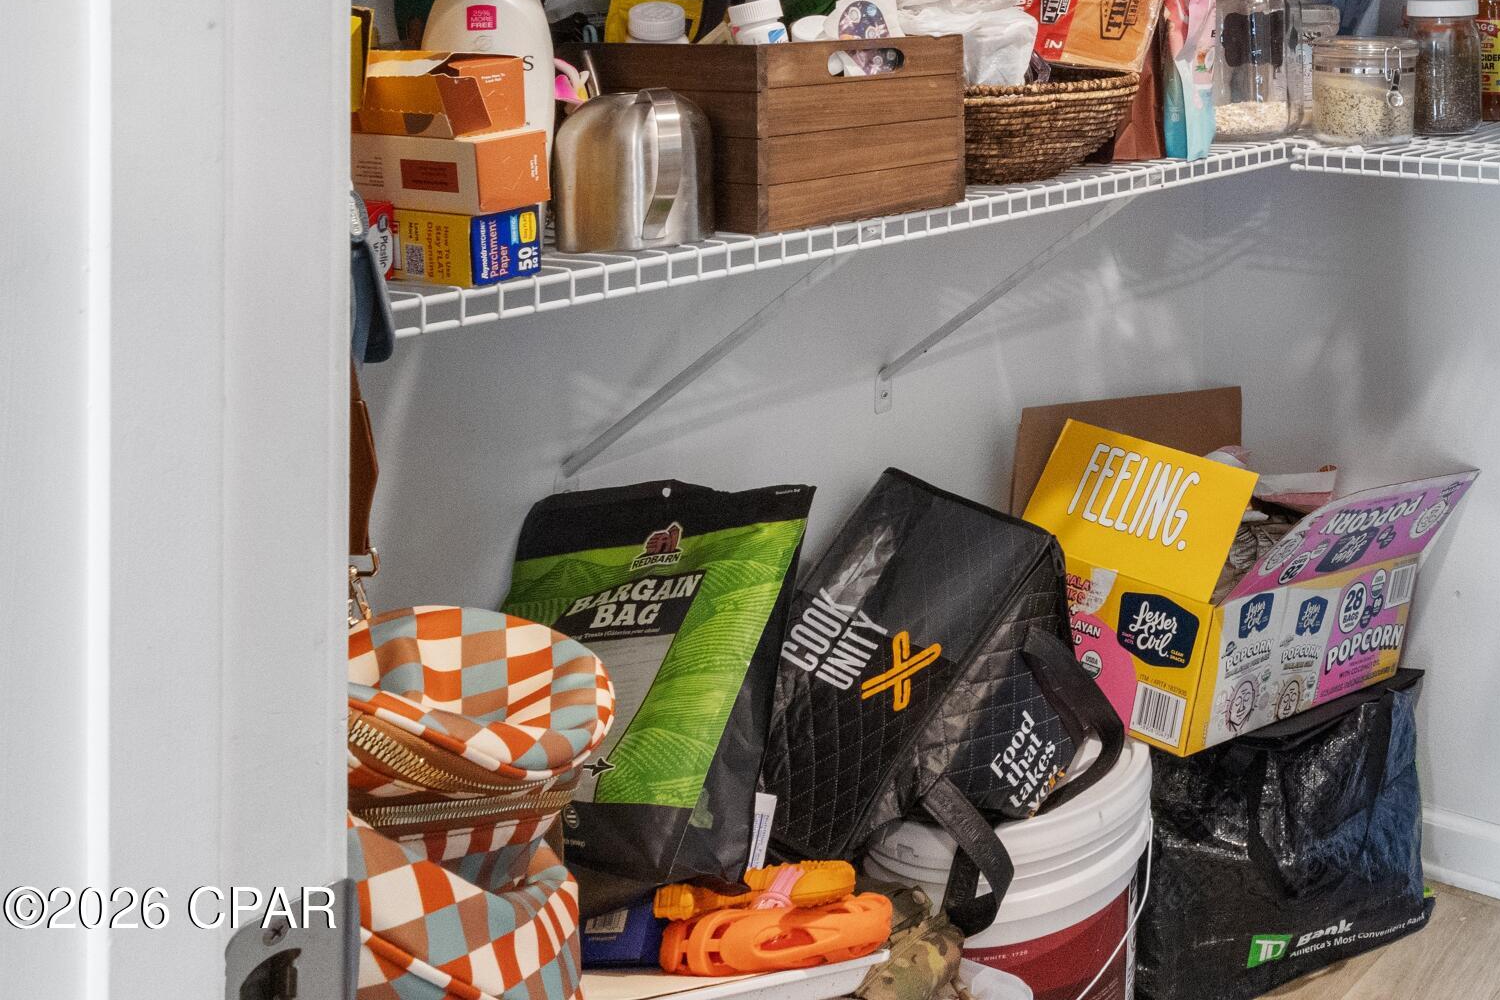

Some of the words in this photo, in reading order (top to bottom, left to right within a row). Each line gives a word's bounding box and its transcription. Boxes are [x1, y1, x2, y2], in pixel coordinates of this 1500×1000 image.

[380, 236, 388, 268] Plastic
[488, 219, 499, 278] Parchment
[499, 245, 511, 276] Paper
[518, 247, 533, 271] 50
[1067, 442, 1201, 551] FEELING.
[631, 552, 682, 569] REDBARN
[565, 573, 703, 617] BARGAIN
[1344, 587, 1365, 614] 28
[590, 602, 662, 629] BAG
[781, 587, 857, 672] COOK
[1129, 601, 1178, 634] Lesser
[815, 609, 889, 690] UNITY
[1226, 640, 1273, 672] POPCORN
[1325, 624, 1404, 676] POPCORN
[990, 710, 1035, 779] Food
[1006, 733, 1043, 787] that
[1009, 740, 1057, 808] takes
[1255, 940, 1287, 962] TD
[1290, 940, 1331, 958] America's
[1333, 934, 1356, 947] Most
[1357, 923, 1406, 940] Convenient
[1407, 912, 1426, 926] Bank
[1296, 919, 1353, 948] Bank
